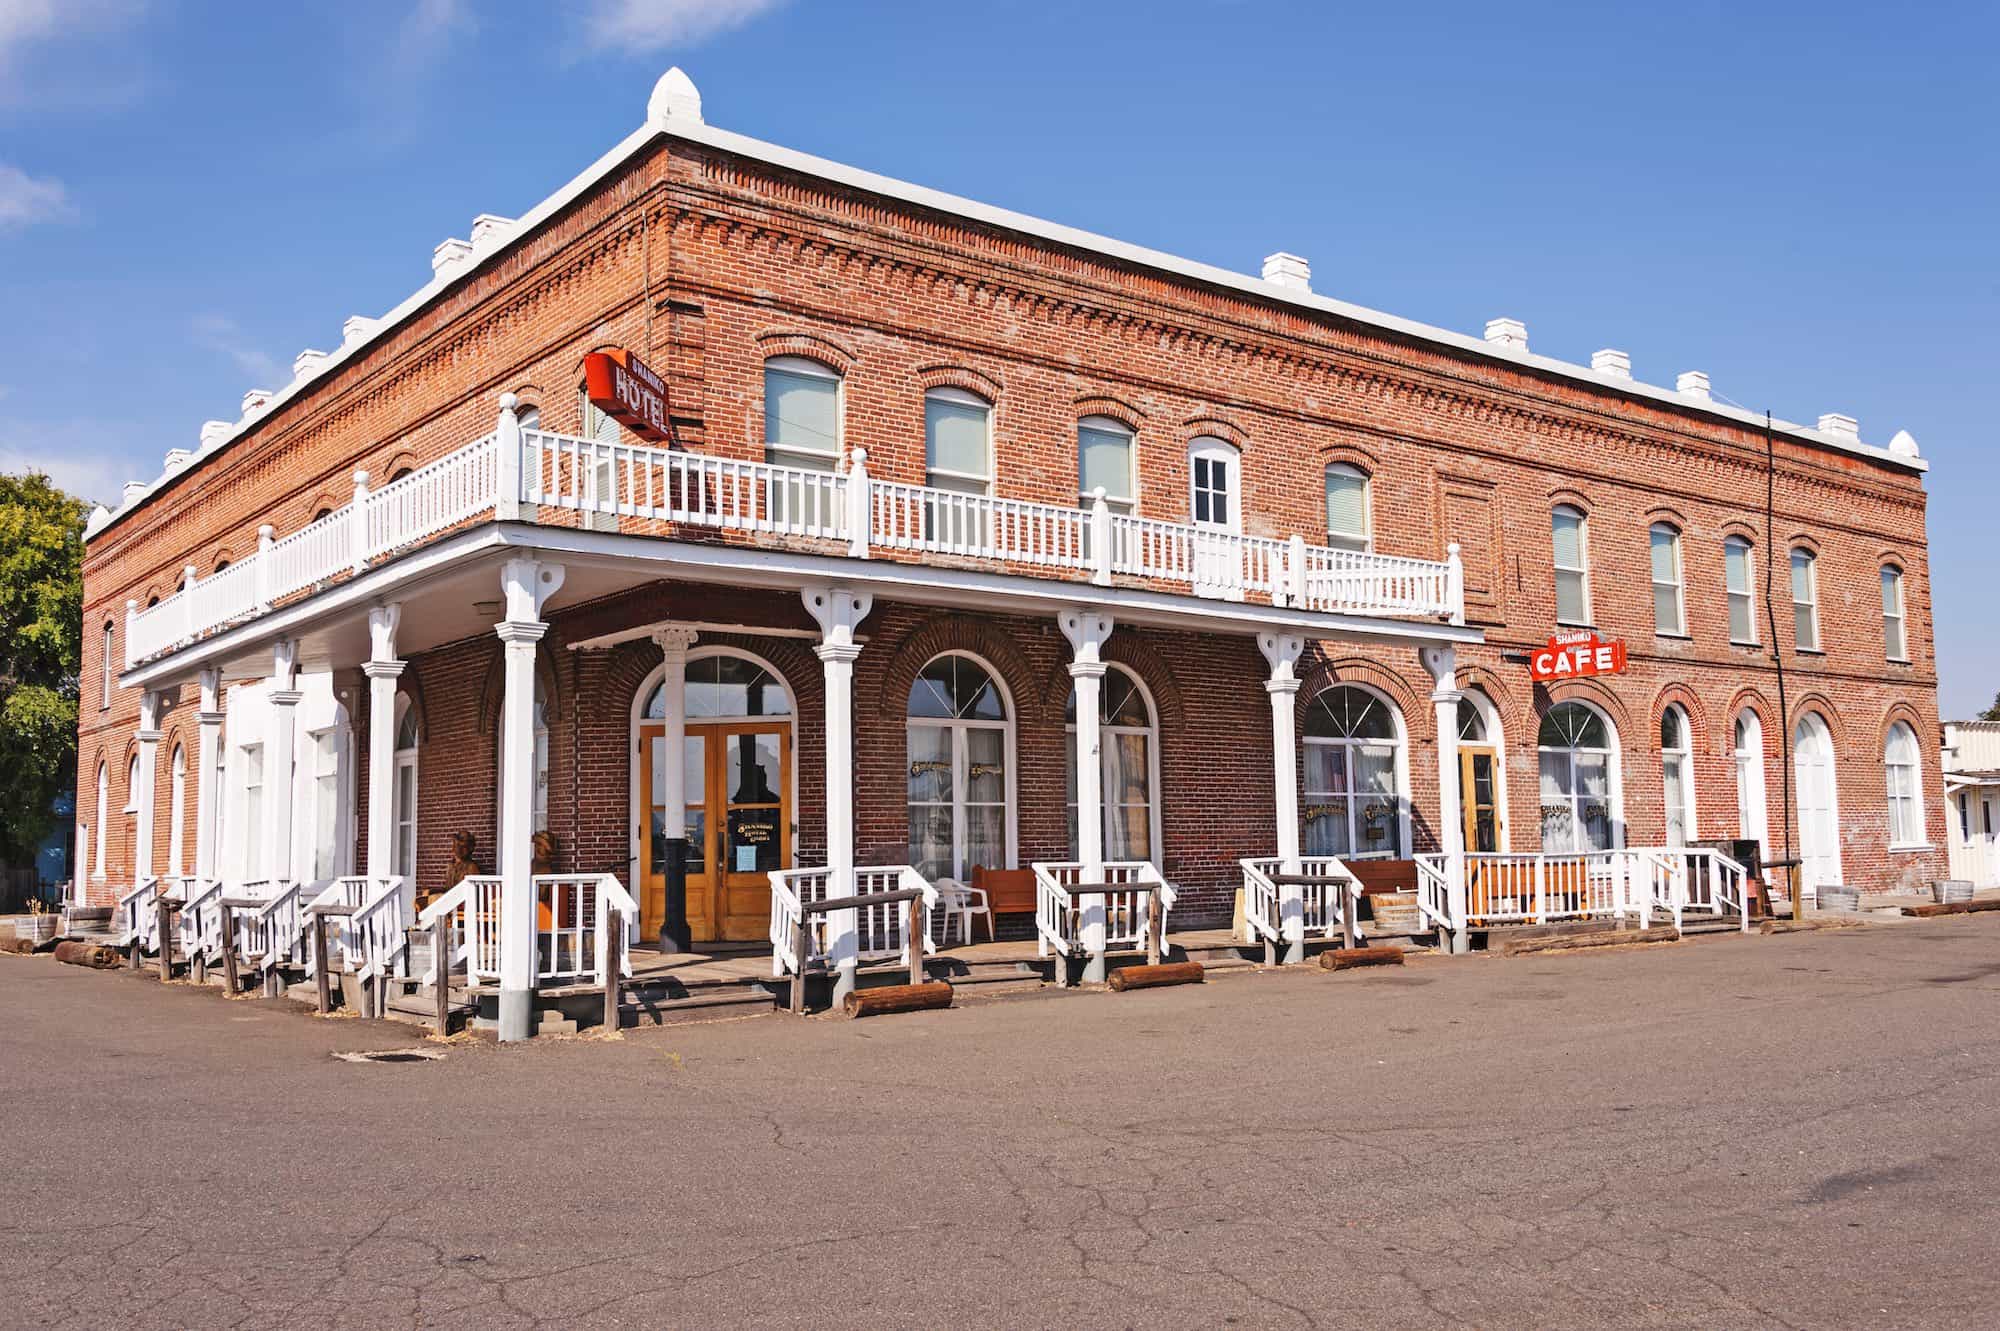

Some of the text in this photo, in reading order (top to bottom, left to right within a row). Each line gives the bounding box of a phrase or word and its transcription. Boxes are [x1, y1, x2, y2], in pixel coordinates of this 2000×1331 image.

[615, 366, 669, 435] HOTEL
[1556, 631, 1592, 645] SHANIKO
[1536, 647, 1613, 674] CAFE
